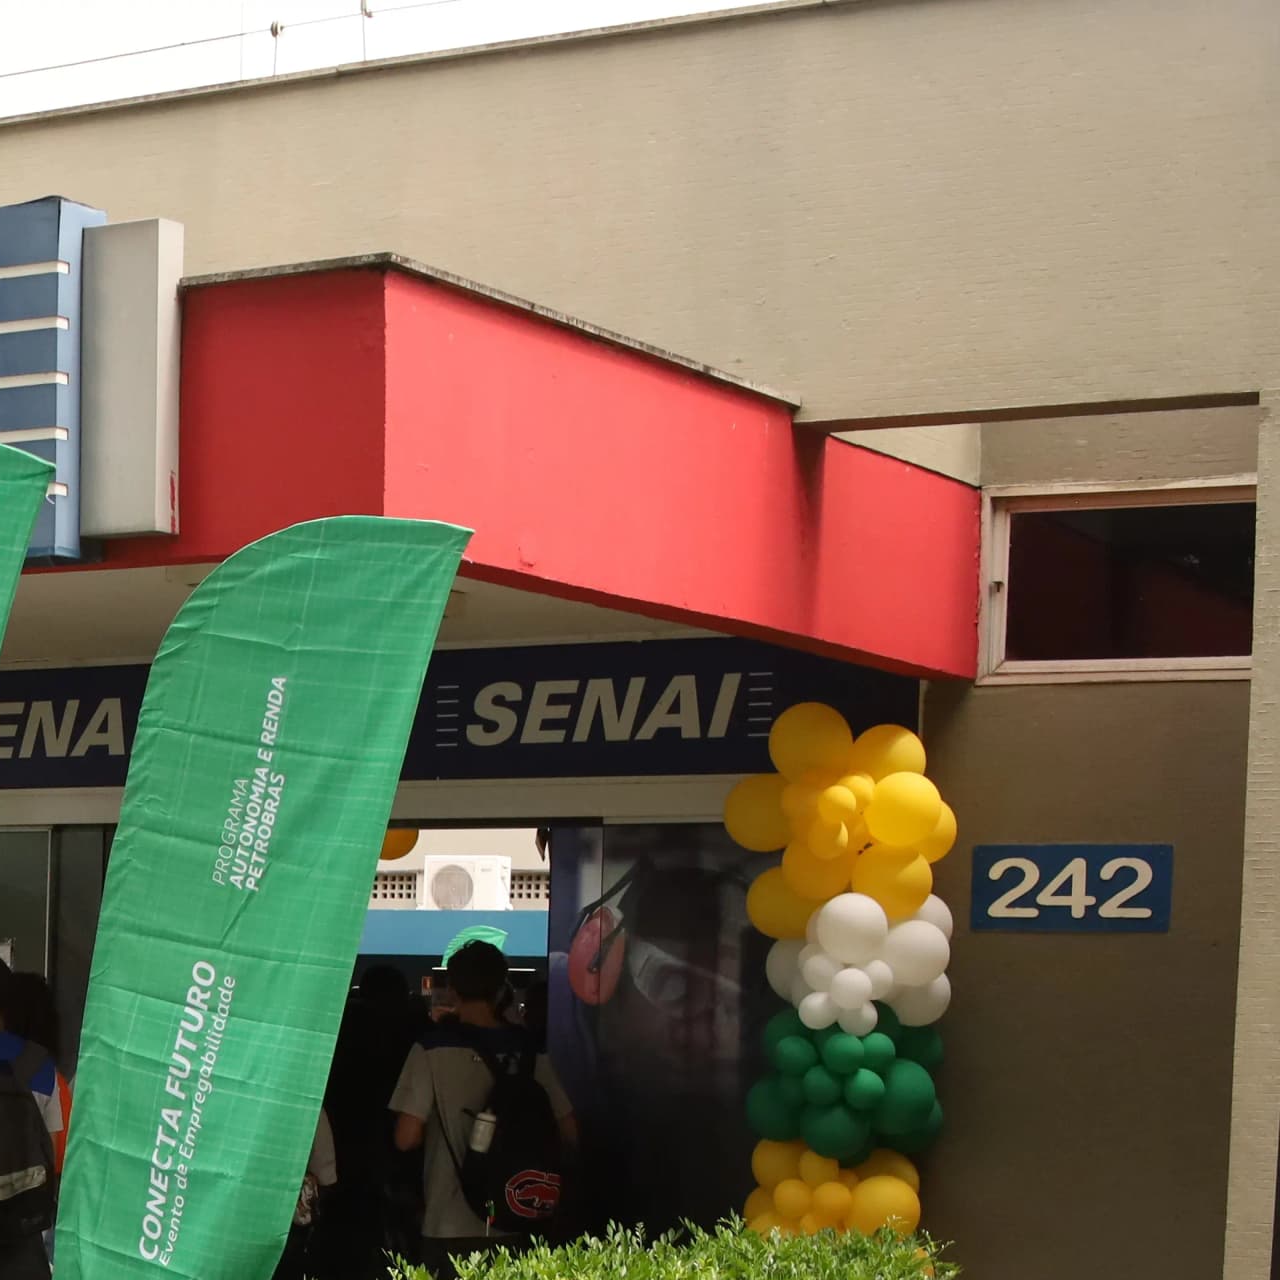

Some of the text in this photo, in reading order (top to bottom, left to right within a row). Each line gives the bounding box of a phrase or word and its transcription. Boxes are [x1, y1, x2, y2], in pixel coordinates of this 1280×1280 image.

[466, 673, 741, 747] SENAI
[212, 778, 248, 885] PROGRAMA
[230, 677, 287, 889] AUTONOMIA E RENDA
[246, 772, 284, 892] PETROBRAS
[987, 857, 1153, 919] 242
[139, 961, 215, 1260] CONECTA FUTURO
[159, 975, 236, 1266] Evento de Empregabilidade
